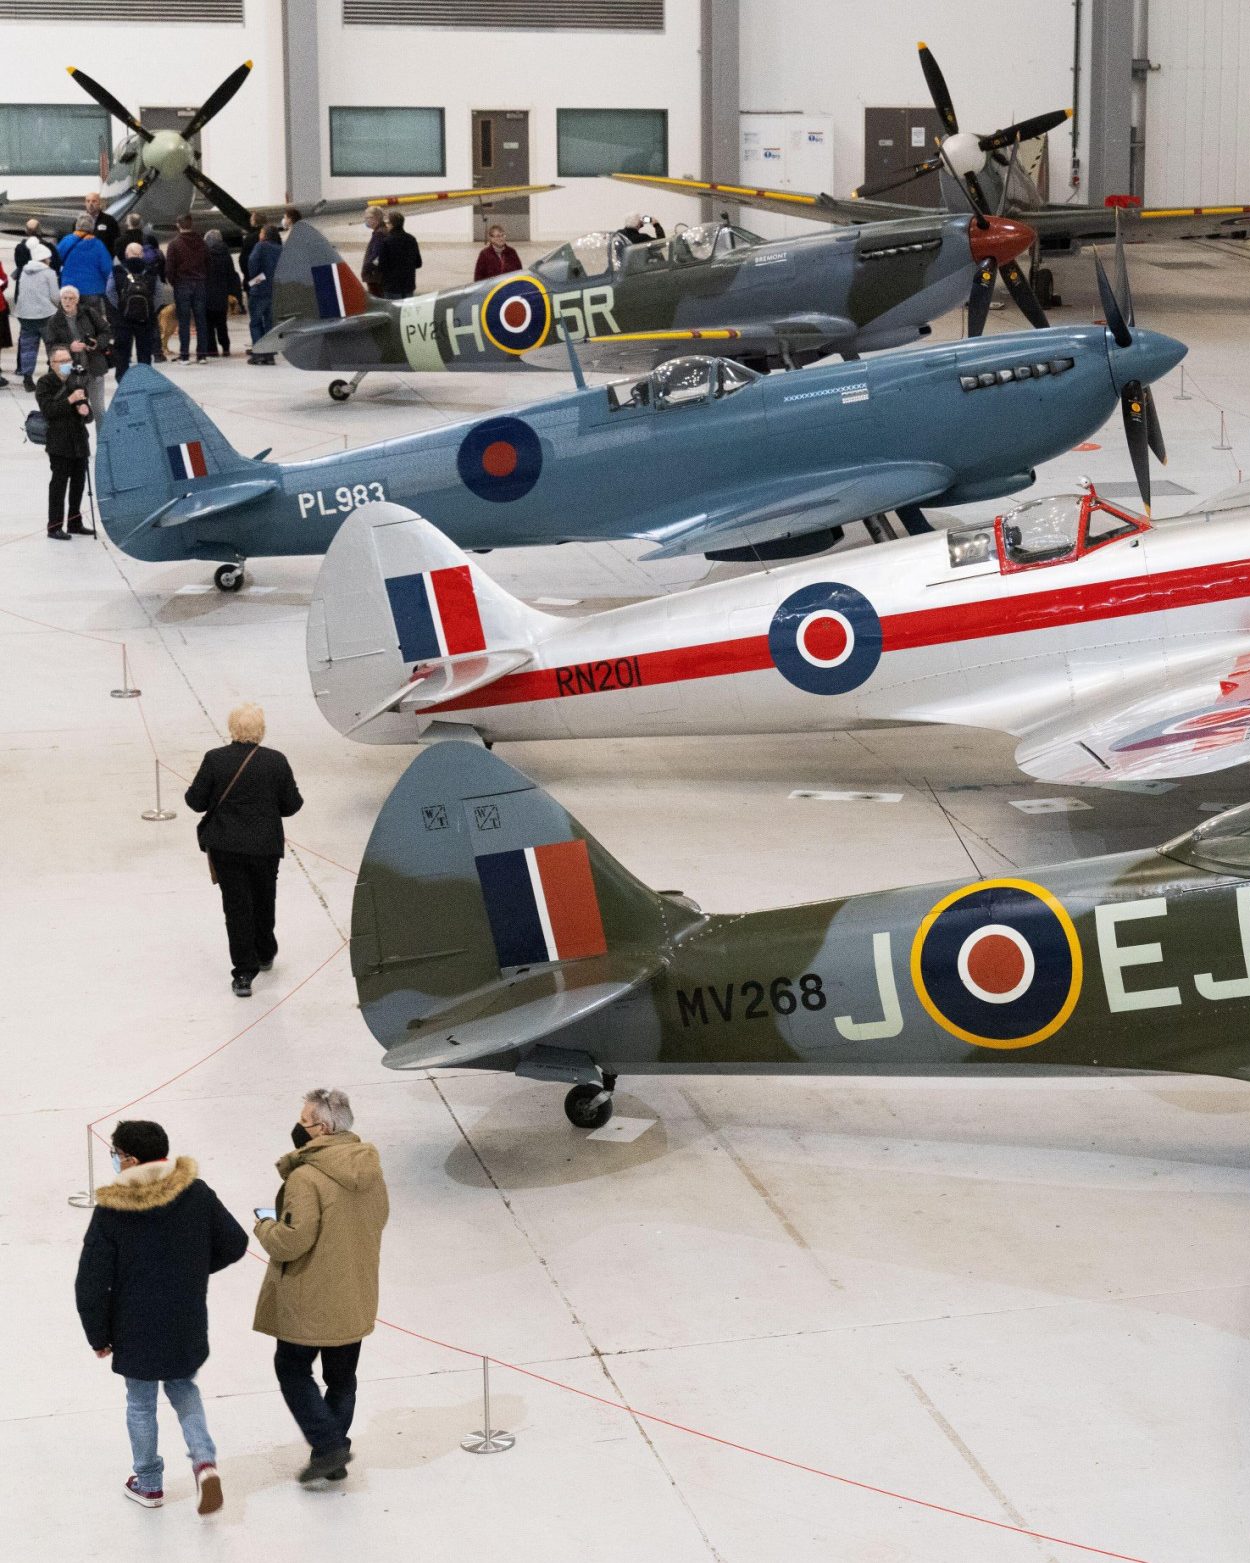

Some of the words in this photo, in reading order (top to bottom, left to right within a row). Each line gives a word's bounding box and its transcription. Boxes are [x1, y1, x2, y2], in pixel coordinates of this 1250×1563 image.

[754, 252, 788, 264] BREMONT
[446, 303, 486, 356] H
[552, 284, 622, 341] 5R
[298, 482, 386, 519] PL983
[555, 656, 642, 699] RN201
[675, 972, 828, 1030] MV268
[834, 931, 905, 1042] J
